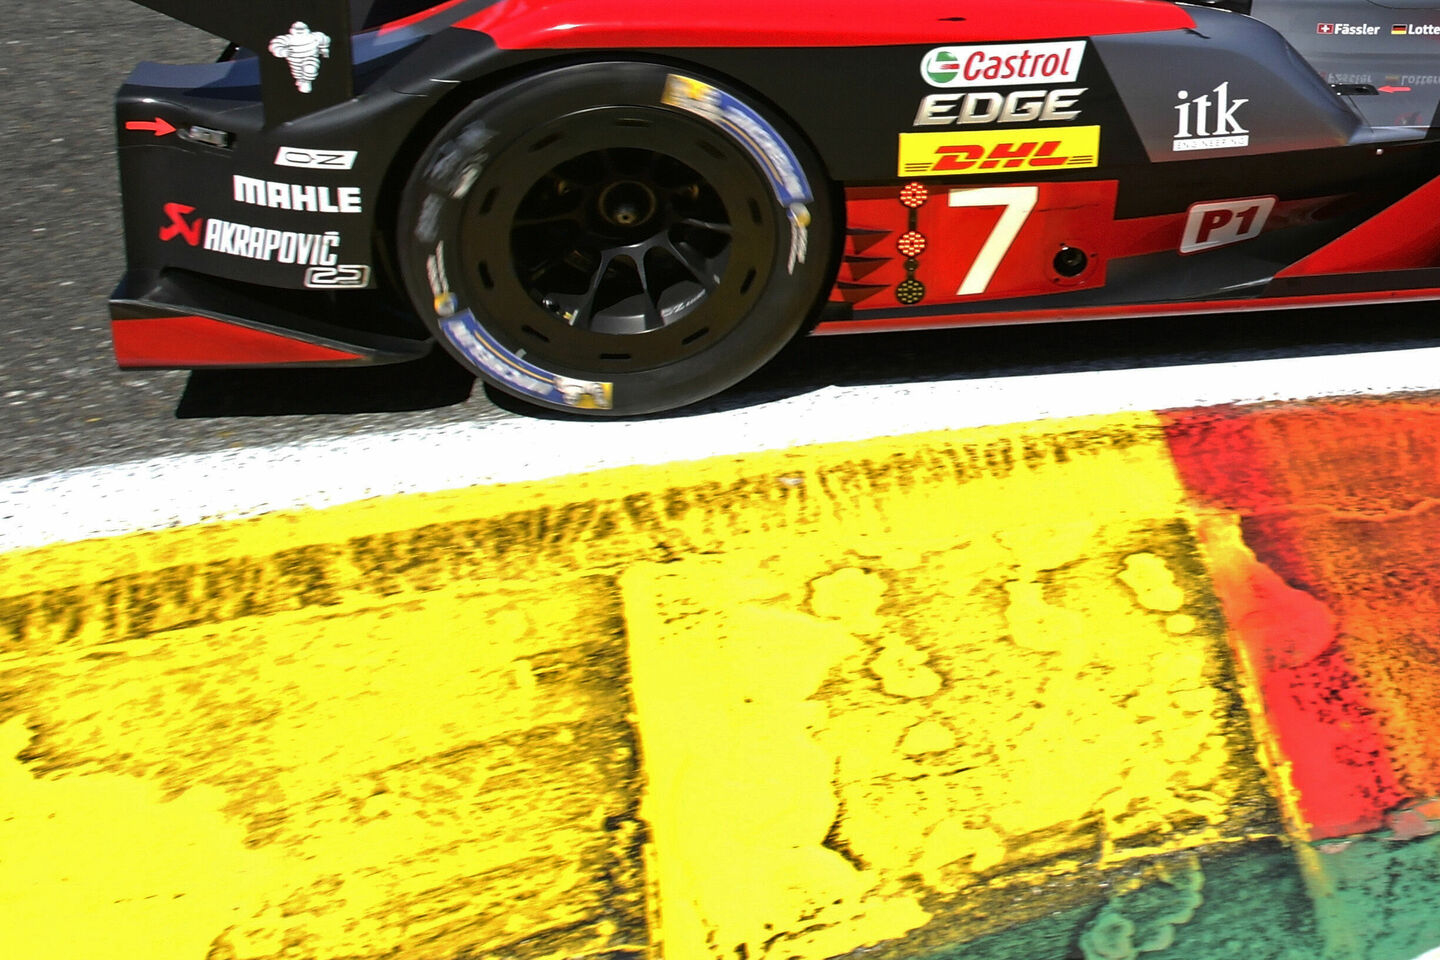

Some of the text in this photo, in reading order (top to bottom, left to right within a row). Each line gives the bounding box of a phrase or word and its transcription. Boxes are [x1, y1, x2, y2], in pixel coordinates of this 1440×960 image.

[1334, 23, 1381, 36] Fässler
[963, 47, 1072, 81] Castrol
[912, 87, 1089, 127] EDGE
[1173, 81, 1250, 138] itk
[931, 140, 1073, 172] DHL
[233, 174, 363, 214] MAHLE
[203, 218, 341, 267] AKRAPOVIČ
[948, 186, 1039, 296] 7
[1195, 204, 1261, 245] P1
